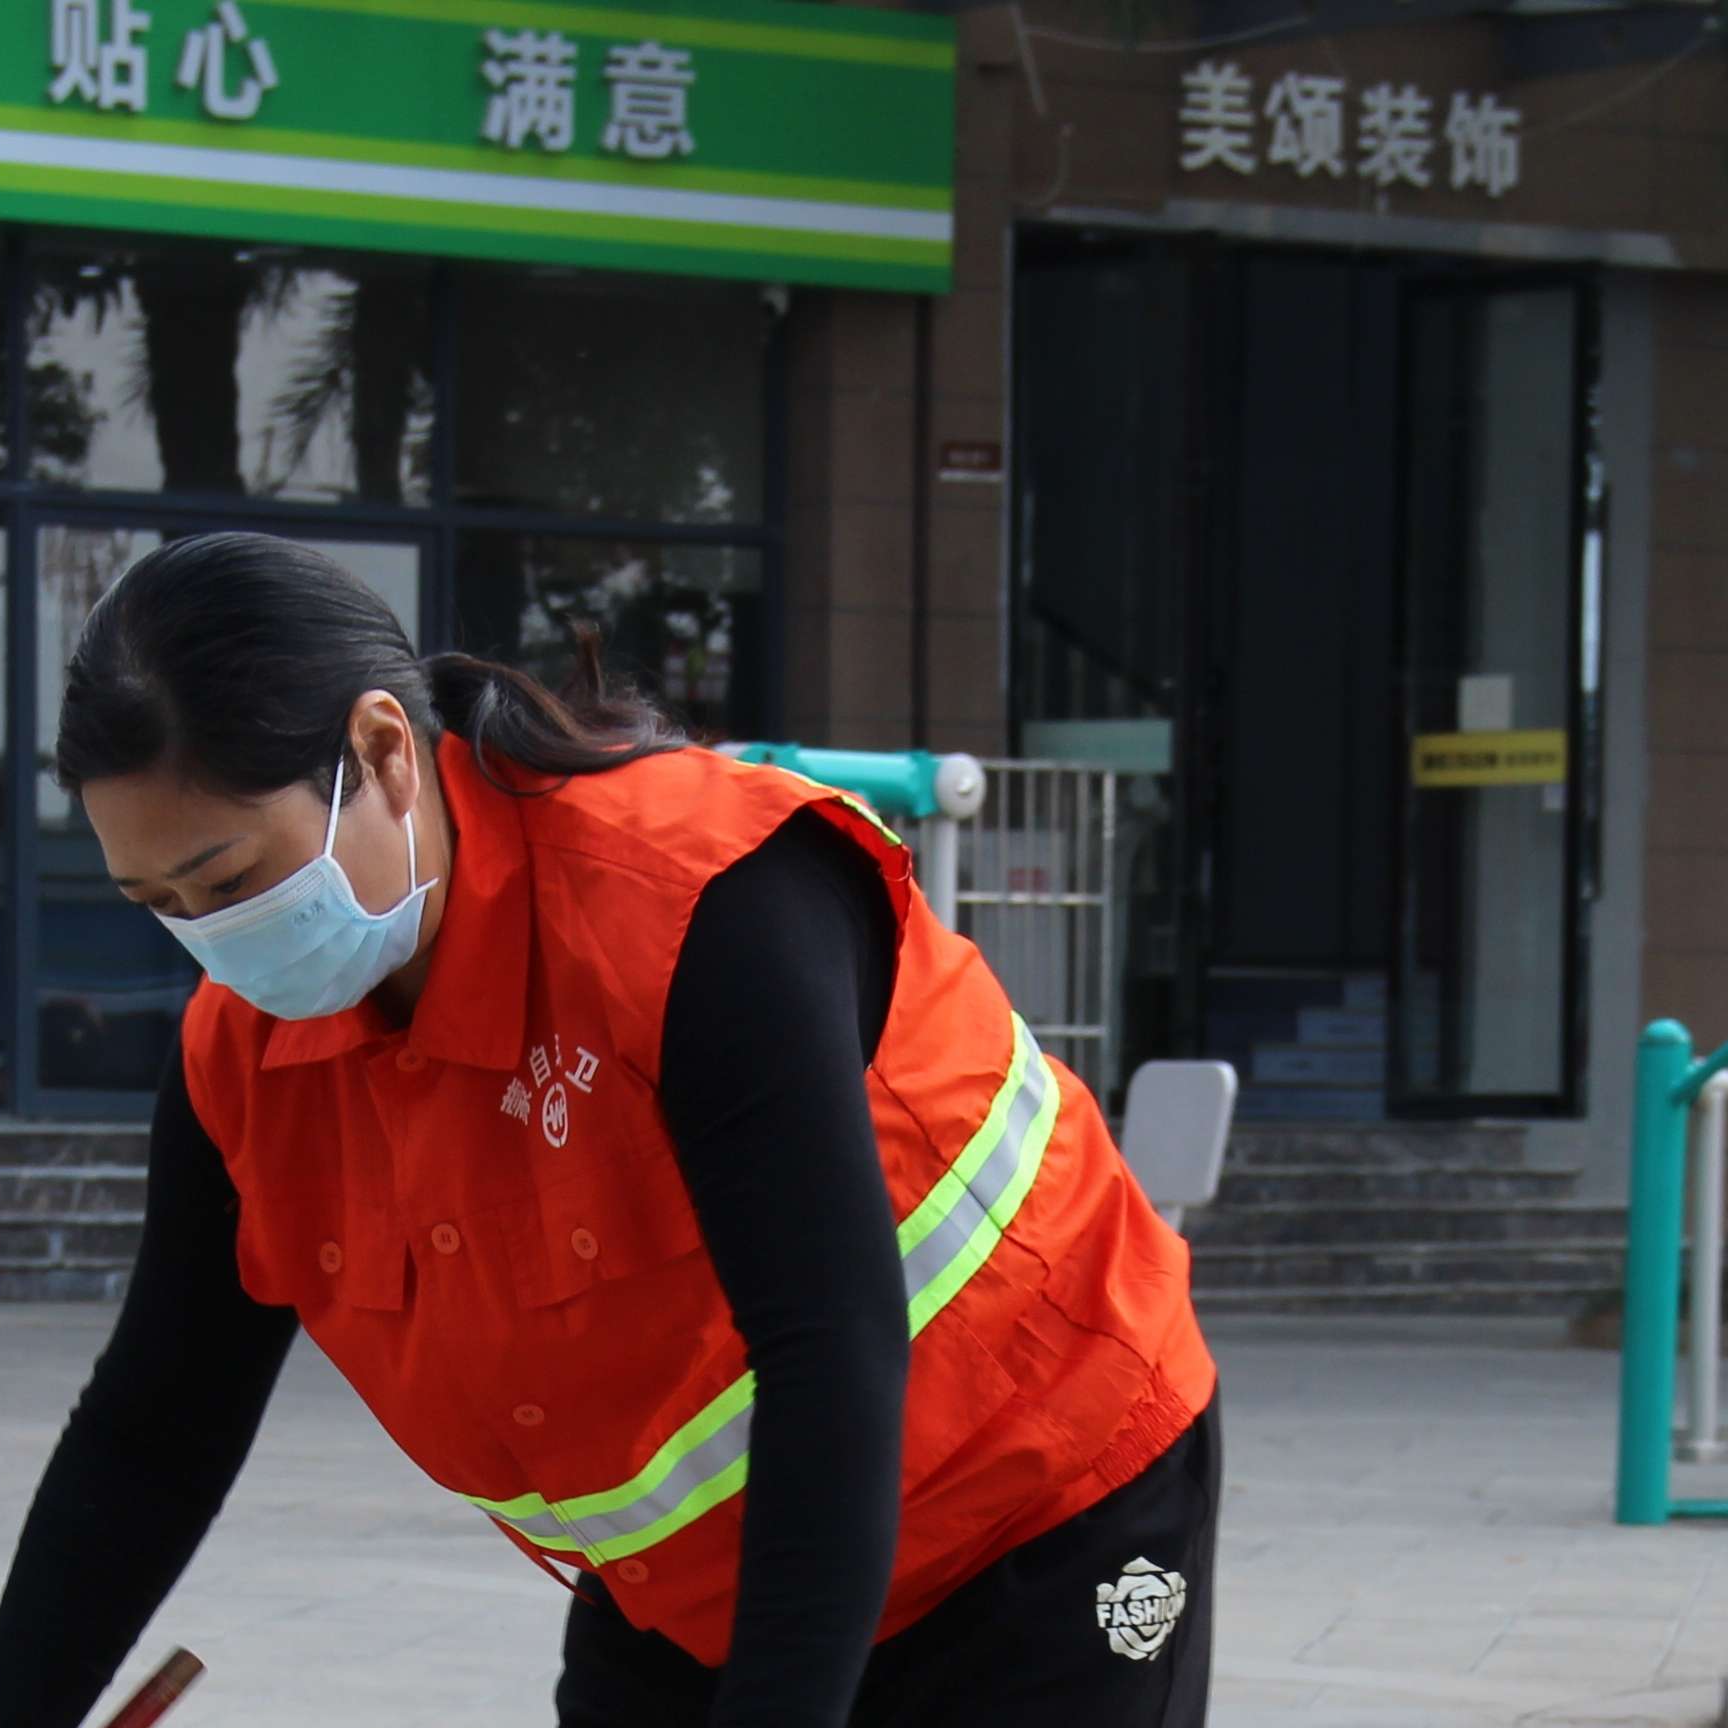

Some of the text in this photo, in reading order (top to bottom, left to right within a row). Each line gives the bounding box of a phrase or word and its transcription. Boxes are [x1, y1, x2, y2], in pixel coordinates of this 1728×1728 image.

[49, 0, 695, 158] 贴心 满意
[1179, 62, 1520, 196] 美颂装饰
[500, 1034, 600, 1126] 蒙自卫
[1096, 1597, 1183, 1628] FASHIO
